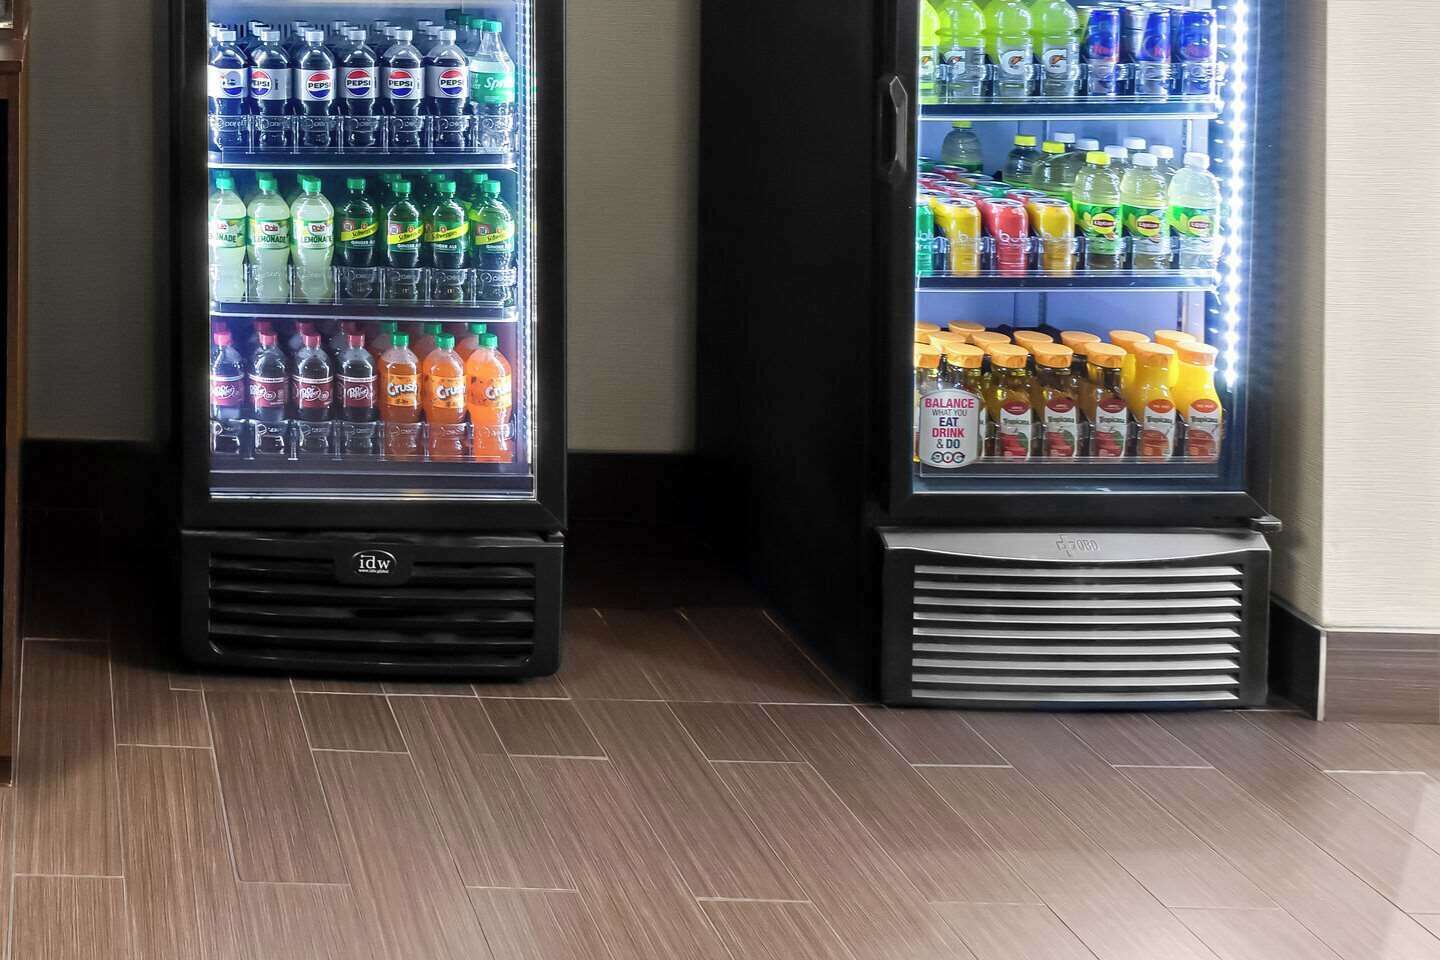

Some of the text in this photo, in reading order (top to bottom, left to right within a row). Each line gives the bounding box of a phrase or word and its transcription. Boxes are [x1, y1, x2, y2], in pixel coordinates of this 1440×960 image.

[440, 79, 463, 87] PEPS
[257, 235, 286, 243] EMONADE
[436, 385, 465, 399] Cru
[924, 398, 974, 409] BALANCE
[939, 417, 959, 427] EAT
[932, 428, 965, 438] DRINK
[936, 439, 961, 449] & DO
[360, 555, 391, 569] idw
